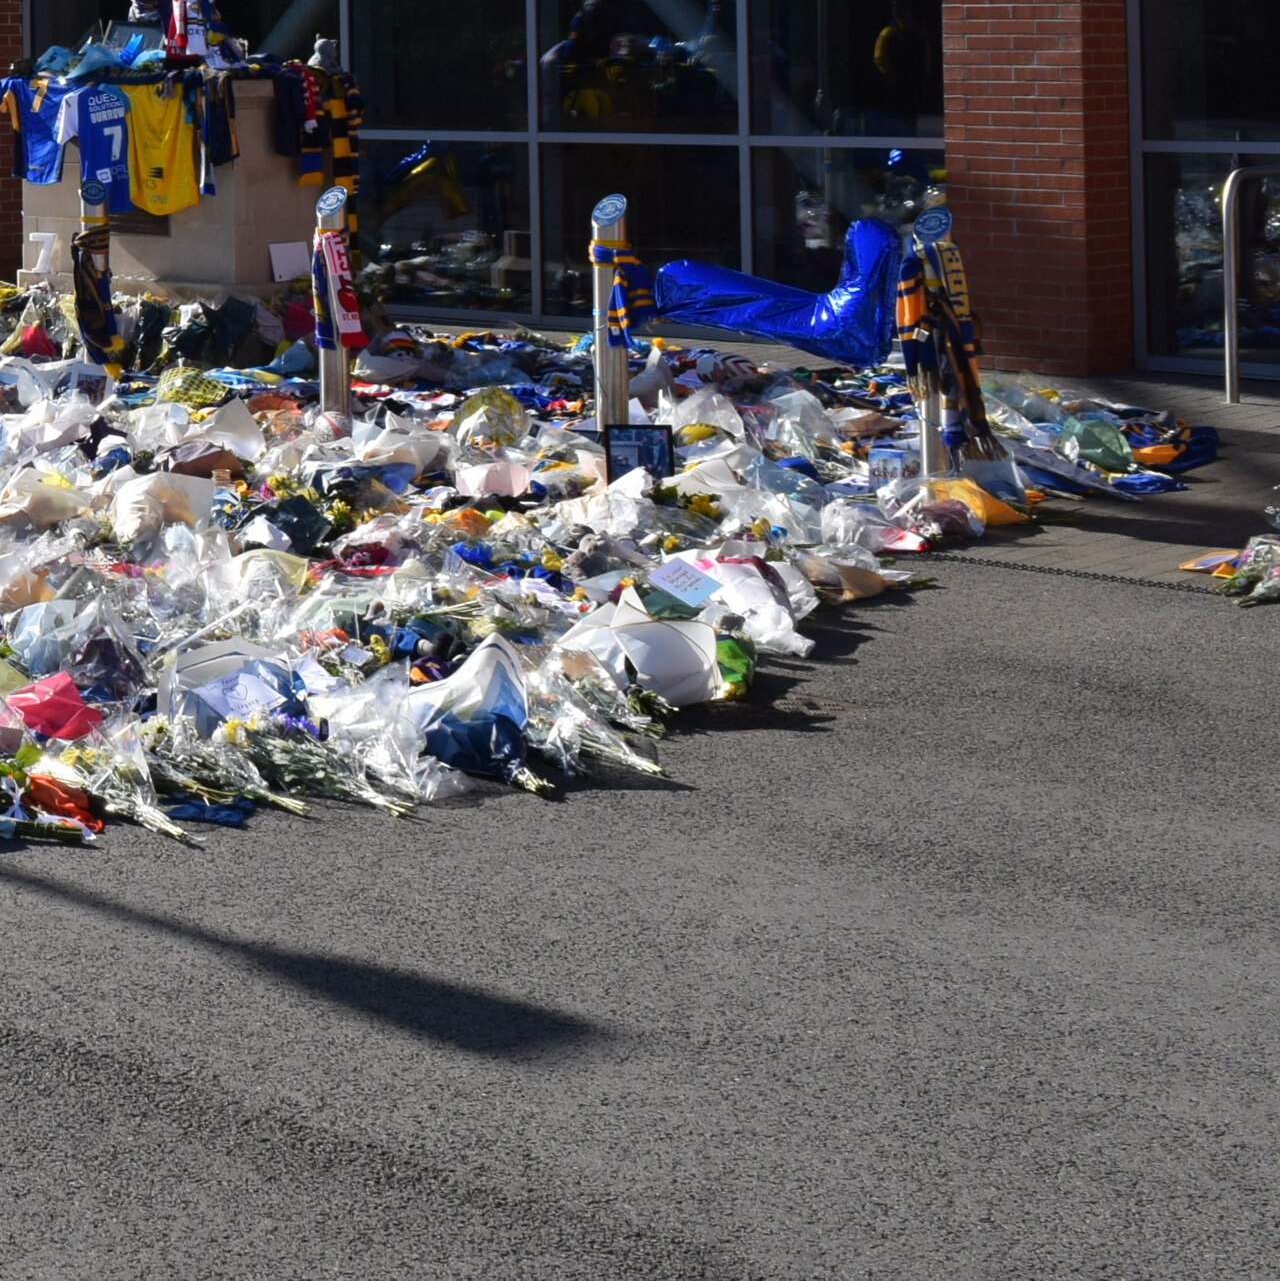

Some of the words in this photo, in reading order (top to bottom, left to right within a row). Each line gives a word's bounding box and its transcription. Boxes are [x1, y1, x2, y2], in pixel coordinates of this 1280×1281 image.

[28, 79, 48, 113] 7
[90, 106, 126, 123] BURROW
[103, 125, 123, 161] 7
